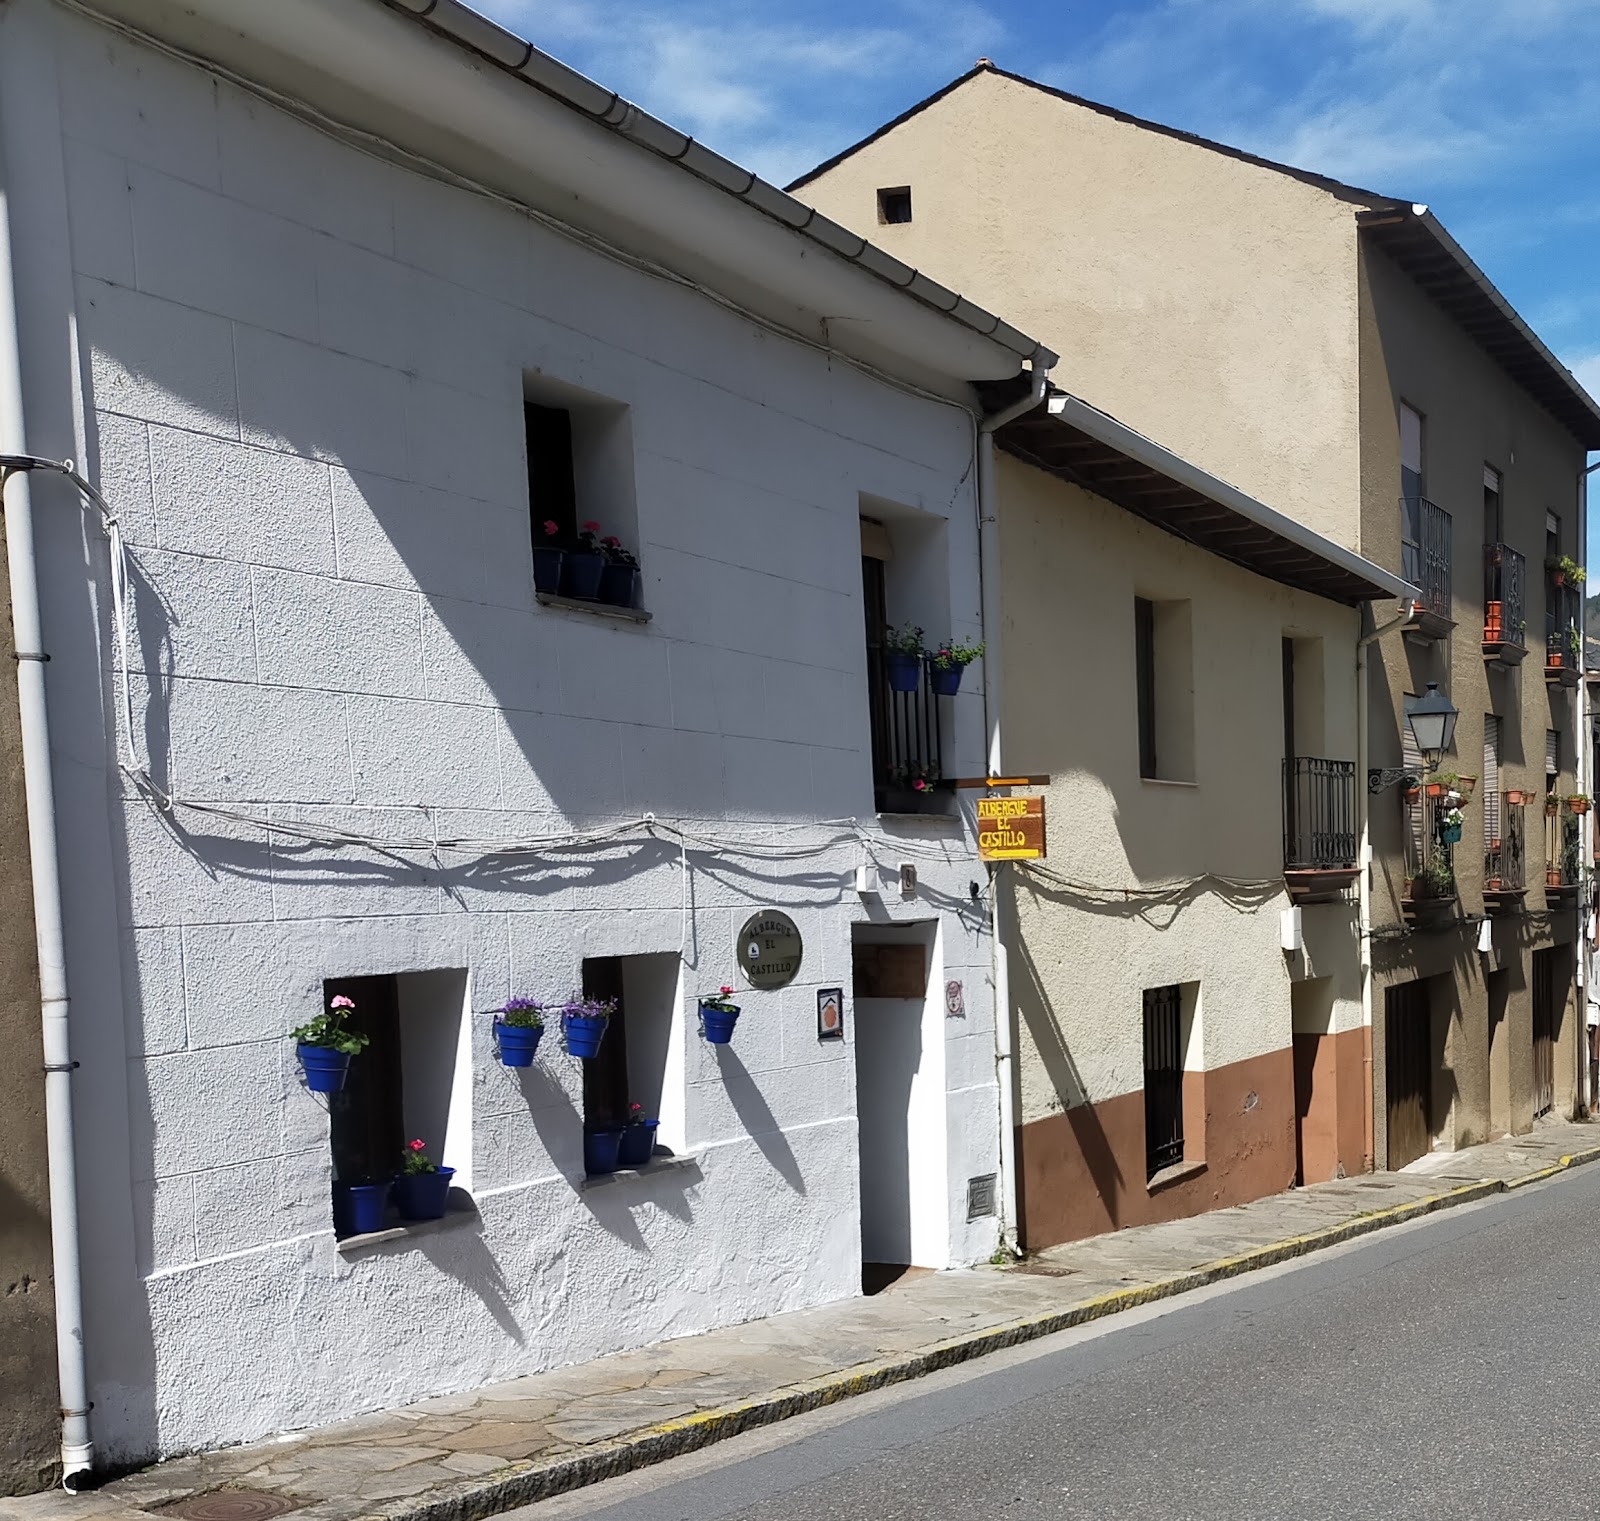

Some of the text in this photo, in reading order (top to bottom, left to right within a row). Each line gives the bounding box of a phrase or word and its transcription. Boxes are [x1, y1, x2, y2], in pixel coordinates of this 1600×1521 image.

[997, 816, 1011, 830] EL
[979, 831, 1026, 847] CASTILLO
[750, 921, 791, 938] ALBERGUE
[765, 940, 776, 949] EL
[751, 962, 791, 975] CASTILLO
